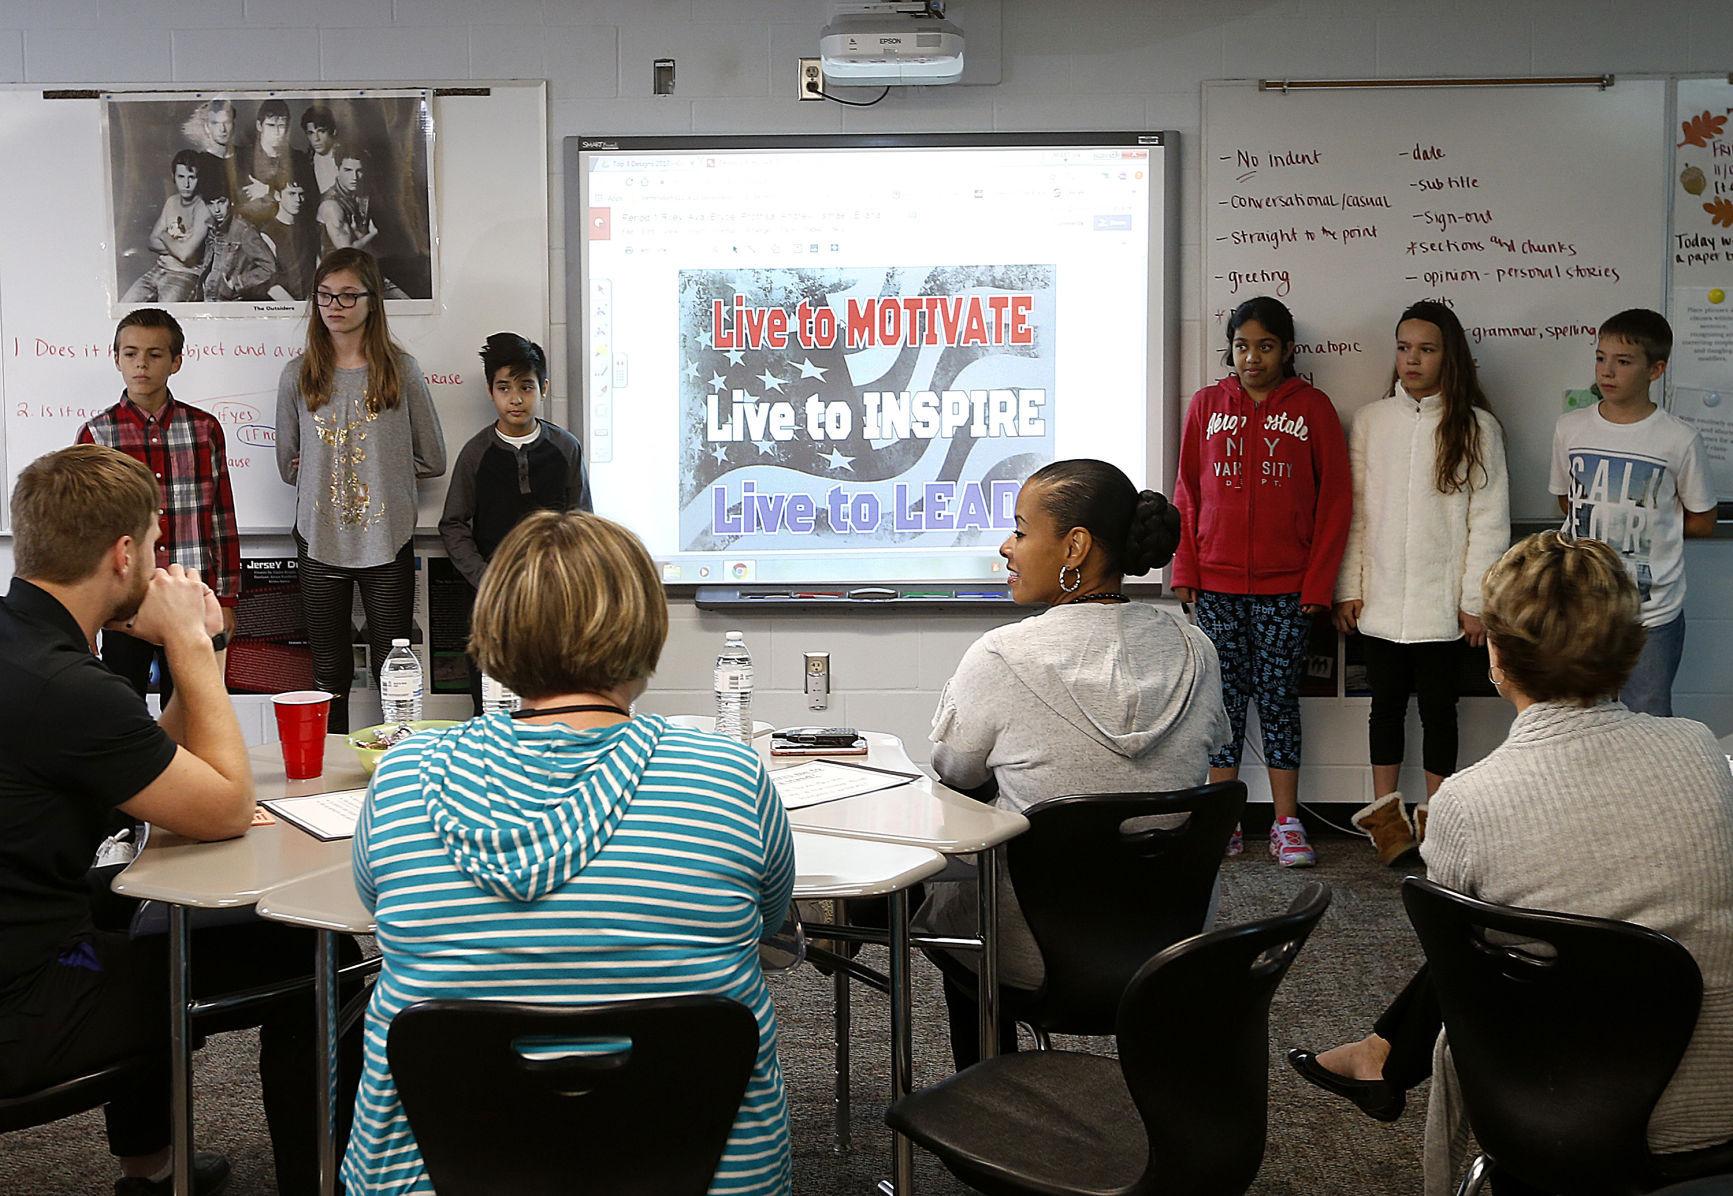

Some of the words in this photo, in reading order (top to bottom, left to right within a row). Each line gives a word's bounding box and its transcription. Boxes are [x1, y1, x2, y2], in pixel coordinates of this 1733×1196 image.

[1237, 150, 1259, 168] No
[1413, 144, 1446, 160] date
[1305, 230, 1315, 241] to
[1343, 226, 1377, 245] point
[1675, 232, 1715, 251] Today
[1522, 240, 1577, 256] chunks
[1676, 254, 1685, 263] a
[1688, 252, 1720, 266] paper
[1228, 270, 1291, 297] greeting
[1424, 269, 1480, 287] opinion
[1497, 265, 1560, 282] personal
[711, 294, 789, 350] Live
[797, 297, 838, 349] to
[846, 294, 1035, 348] MOTIVATE
[35, 338, 76, 358] Does
[85, 344, 99, 357] it
[181, 341, 225, 361] bject
[233, 342, 266, 357] and
[273, 345, 284, 358] a
[1327, 340, 1362, 356] topic
[230, 411, 253, 423] yes
[706, 389, 796, 441] Live
[805, 393, 852, 440] to
[862, 388, 1046, 440] INSPIRE
[712, 480, 817, 535] Live
[826, 484, 882, 534] to
